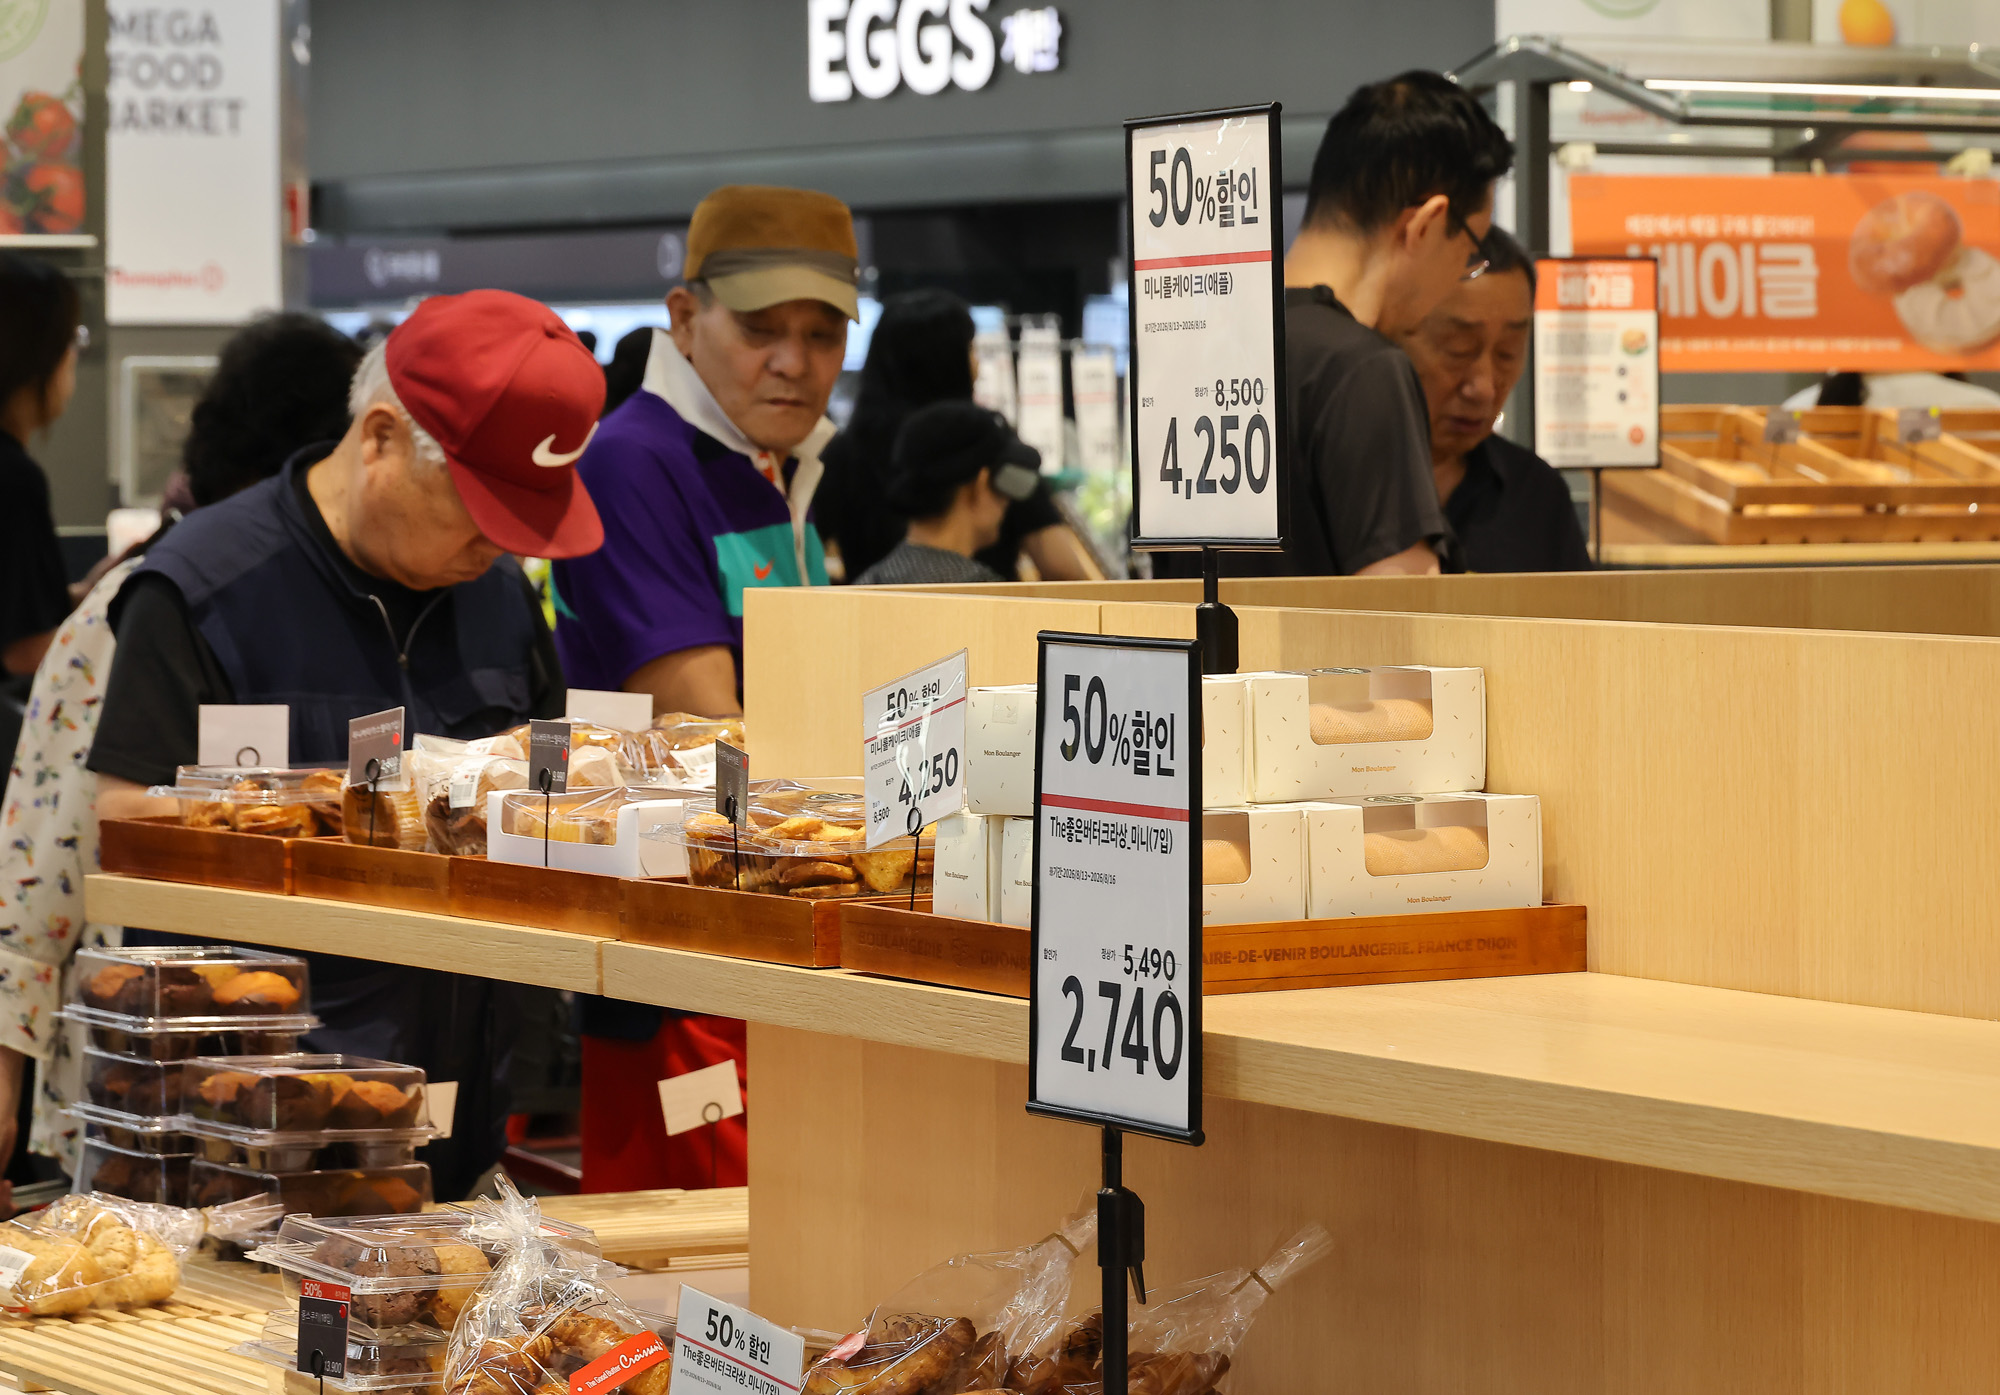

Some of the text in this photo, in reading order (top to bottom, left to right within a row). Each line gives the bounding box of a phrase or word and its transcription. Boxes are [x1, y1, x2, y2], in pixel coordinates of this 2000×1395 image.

[108, 53, 223, 90] FOOD
[808, 0, 996, 102] EGGS
[1149, 147, 1259, 228] 50%할인
[1144, 272, 1233, 300] 미니롤케이크(애플)
[1215, 377, 1264, 411] 8,500
[1160, 413, 1271, 499] 4,250
[1060, 674, 1175, 777] 50%할인
[1050, 816, 1173, 855] The좋은버터크라상_미니(7입)
[1123, 944, 1176, 981] 5,490
[1061, 975, 1183, 1080] 2,740
[304, 1282, 323, 1298] 50%
[705, 1307, 771, 1365] 50% 할인
[585, 1339, 664, 1389] The Good Butter Croissant
